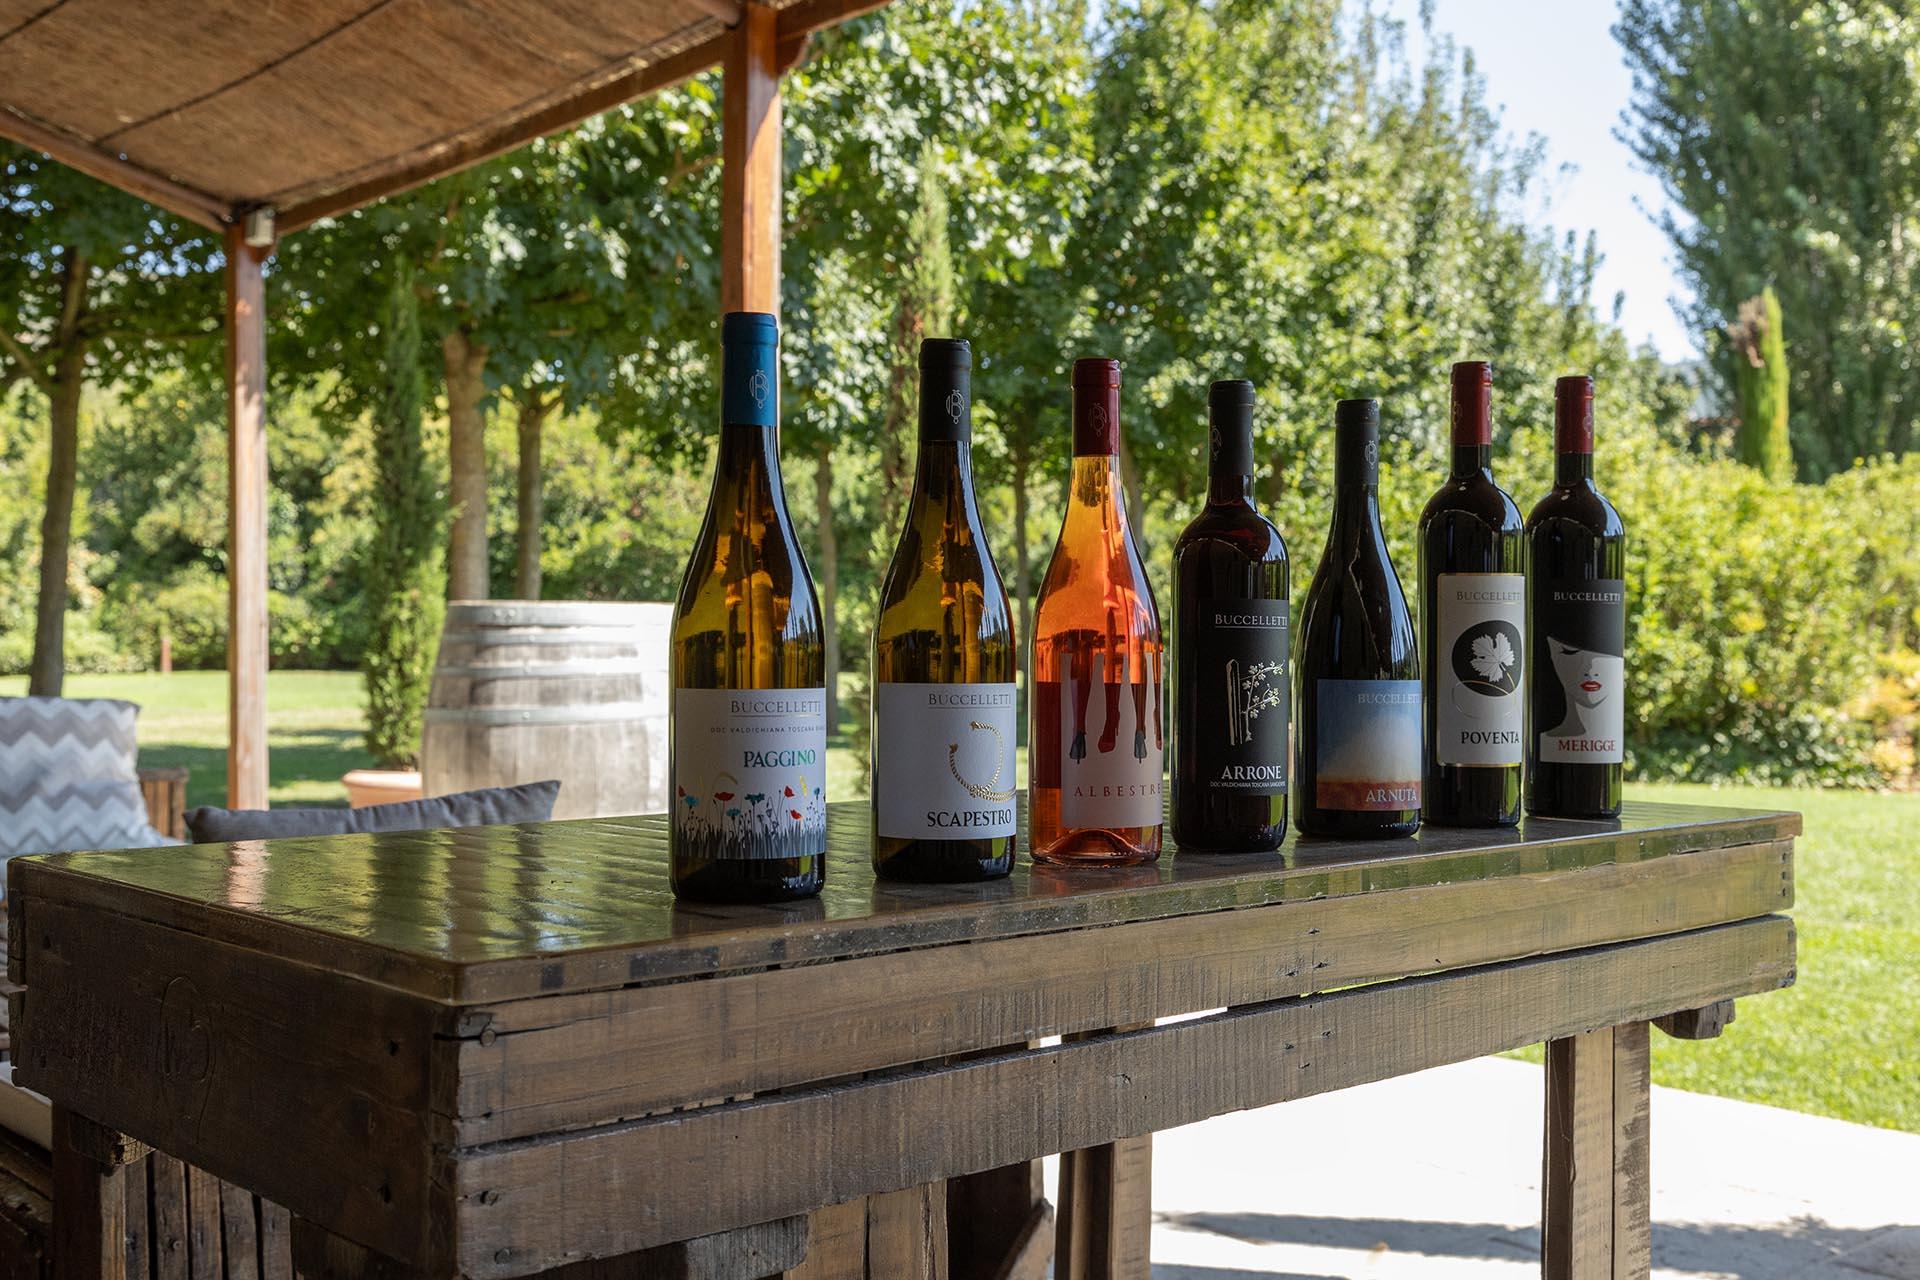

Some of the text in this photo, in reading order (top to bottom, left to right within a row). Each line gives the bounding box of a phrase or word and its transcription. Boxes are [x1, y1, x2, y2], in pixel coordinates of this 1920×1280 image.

[928, 693, 1011, 705] BUCCELLETTI
[1461, 731, 1520, 744] POVENTA
[743, 749, 816, 768] PAGGINO
[1221, 765, 1282, 780] ARRONE
[1366, 788, 1417, 802] ARNUTA
[927, 809, 1012, 827] SCAPESTRO
